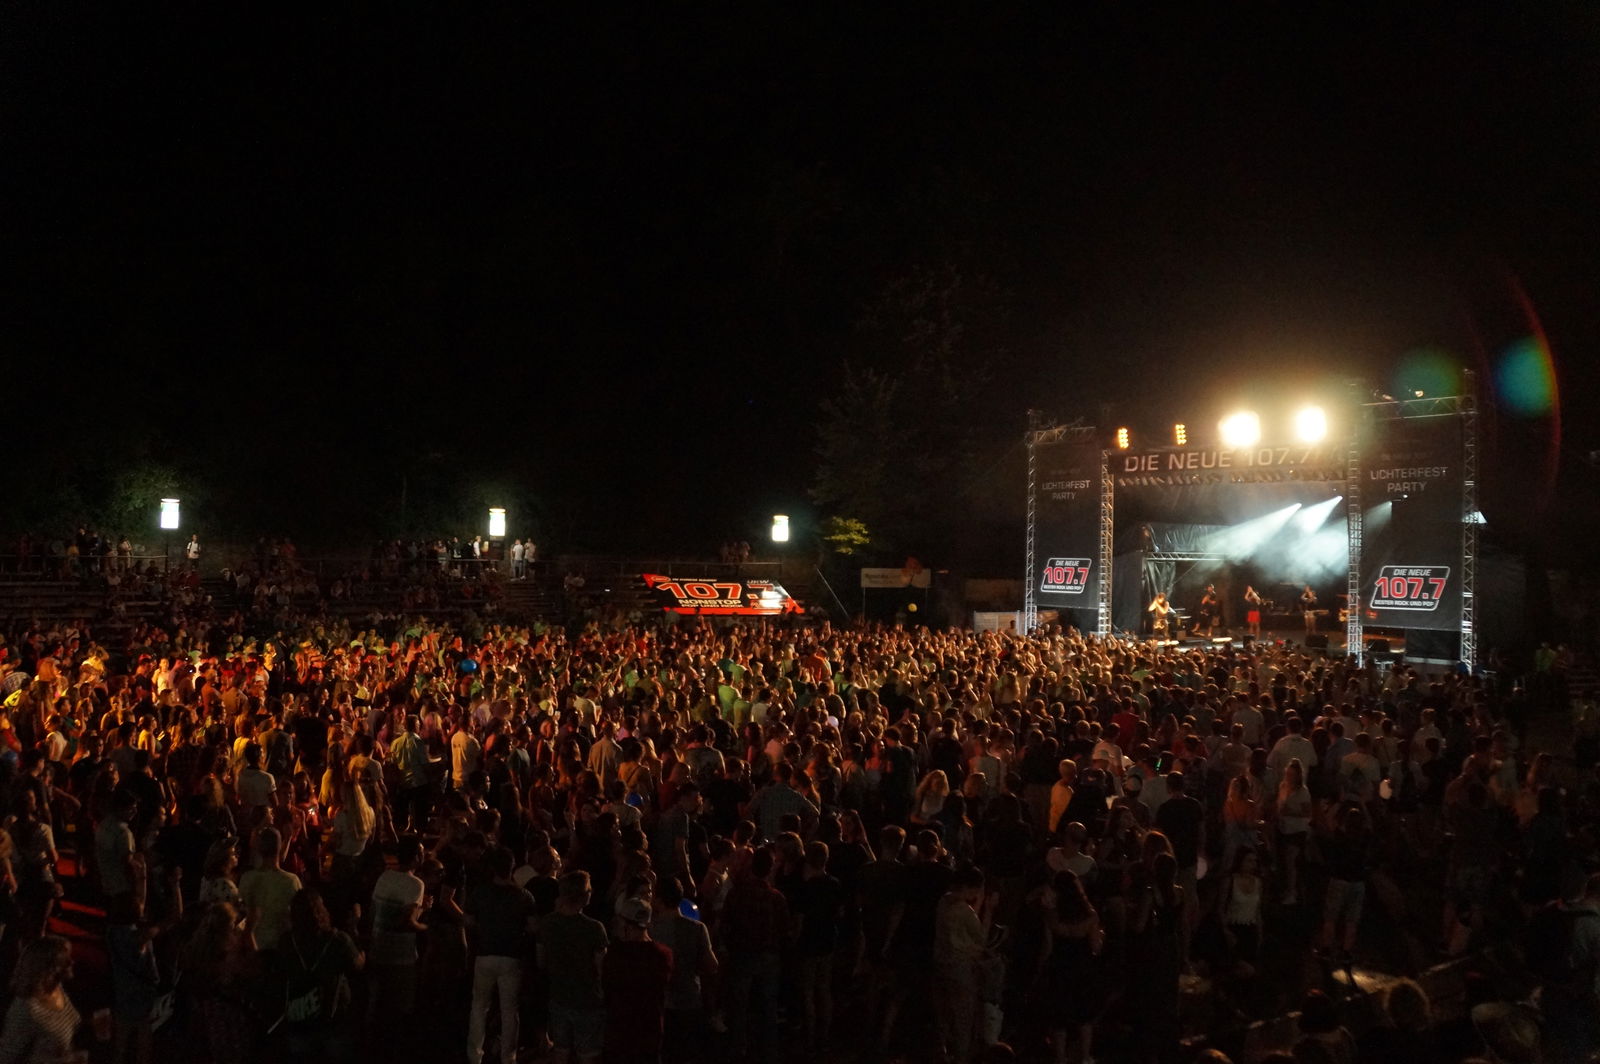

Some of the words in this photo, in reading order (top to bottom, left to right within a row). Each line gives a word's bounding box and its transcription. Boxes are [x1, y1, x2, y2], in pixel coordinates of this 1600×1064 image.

[1124, 453, 1159, 472] DIE
[1168, 450, 1232, 470] NEUE
[1370, 466, 1448, 480] LICHTERFEST
[1387, 481, 1427, 493] PARTY
[1052, 491, 1076, 500] PARTY
[1043, 566, 1089, 585] 107.7
[1393, 568, 1408, 576] DIE
[1408, 568, 1432, 576] NEUE
[1374, 576, 1446, 600] 107.7
